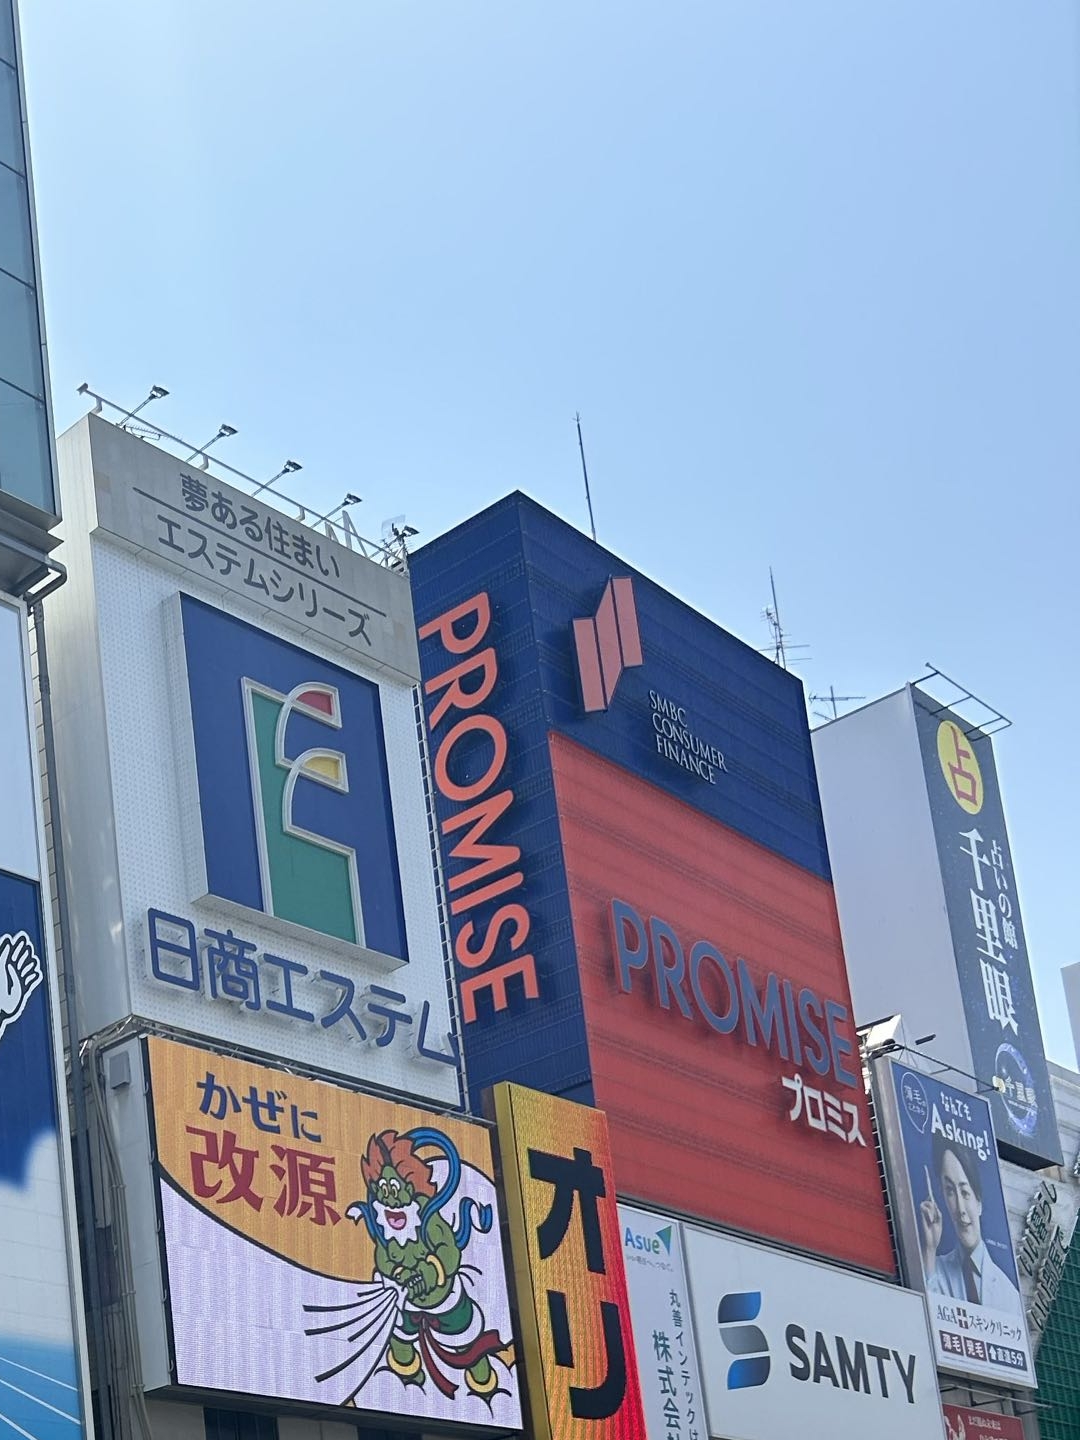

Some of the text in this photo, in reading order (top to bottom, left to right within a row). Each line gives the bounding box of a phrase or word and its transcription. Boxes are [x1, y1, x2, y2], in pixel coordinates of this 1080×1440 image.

[180, 472, 340, 578] 夢ある住まい
[157, 514, 371, 646] エステムシリーズ
[649, 689, 688, 728] SMBC
[652, 712, 728, 773] CONSUMER
[656, 733, 717, 785] FINANCE
[947, 726, 979, 806] 占
[418, 591, 540, 1025] PROMISE
[959, 828, 1019, 1036] 千里眼
[991, 840, 1019, 949] 占いの館
[147, 906, 459, 1067] 日商エステム
[610, 897, 859, 1090] PROMISE
[196, 1071, 322, 1143] かぜに
[781, 1073, 868, 1148] プロミス
[931, 1103, 991, 1161] Asking!
[940, 1091, 972, 1121] なんでも
[185, 1125, 342, 1227] 改源
[624, 1226, 661, 1255] Asue
[937, 1304, 1022, 1342] AGA スキンクリニック
[785, 1323, 916, 1404] SAMTY
